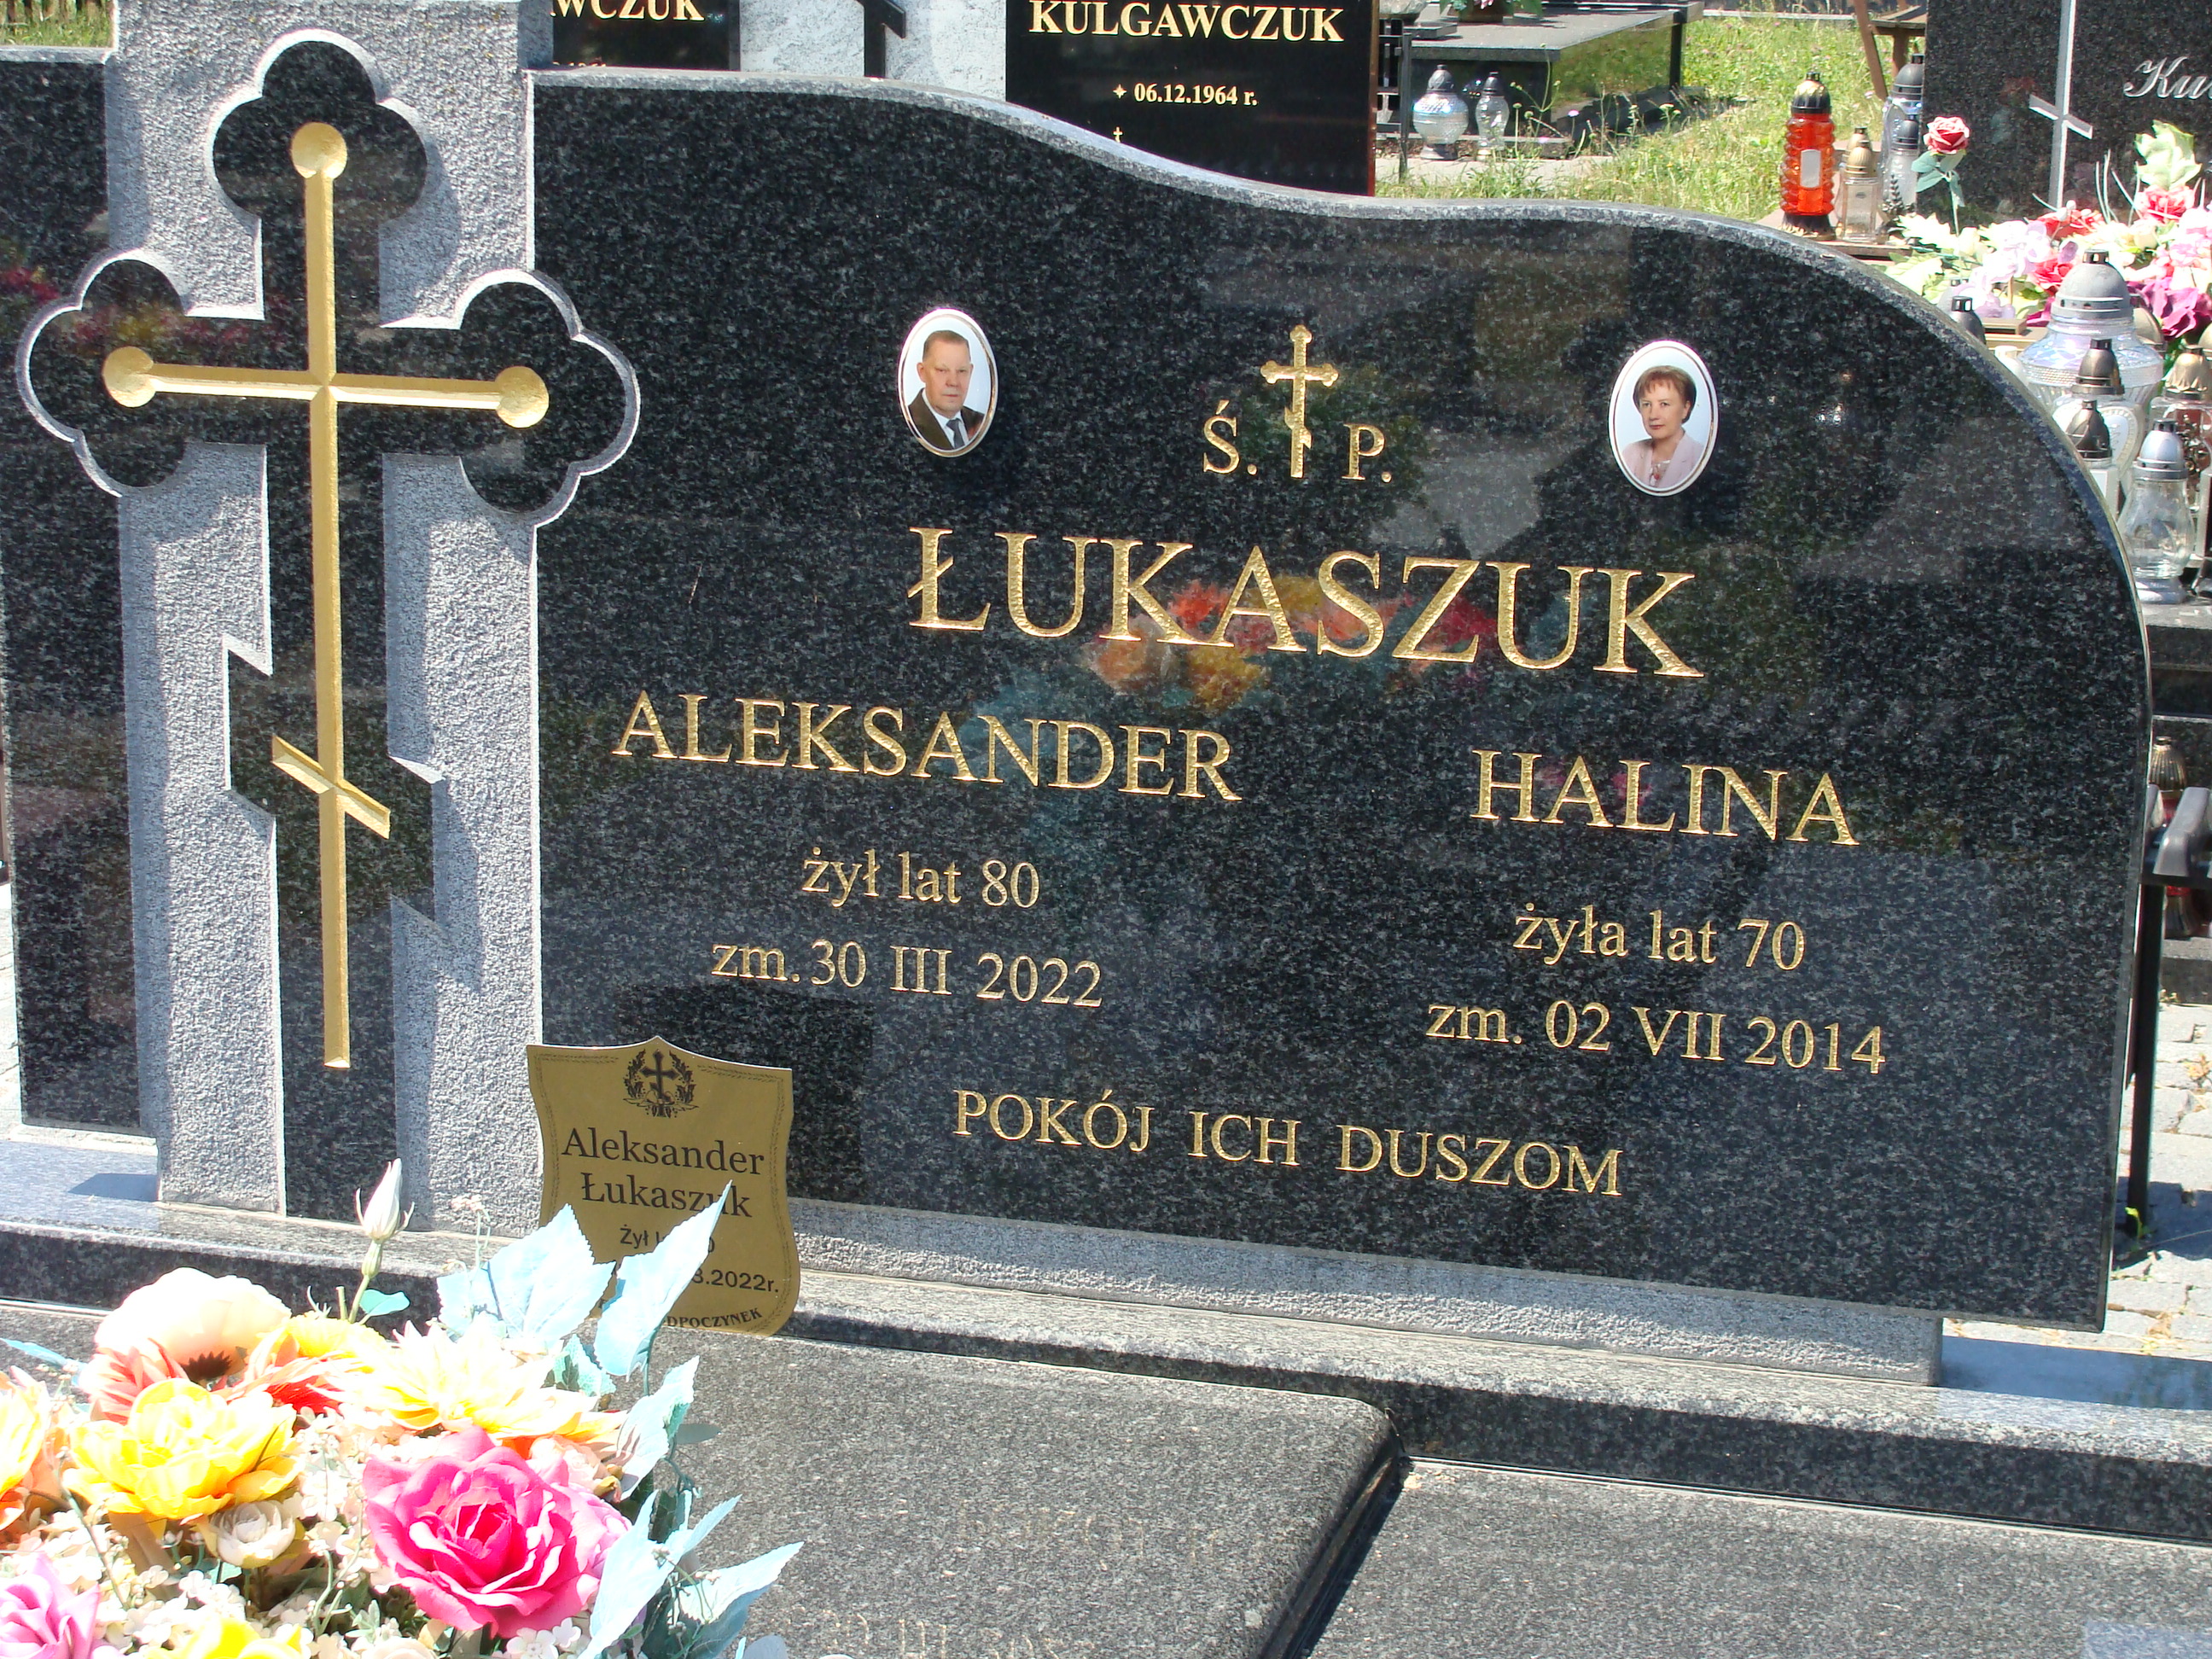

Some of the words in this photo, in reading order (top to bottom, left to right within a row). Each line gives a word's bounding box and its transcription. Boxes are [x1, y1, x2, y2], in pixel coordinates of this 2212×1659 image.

[550, 0, 706, 21] WCZUK
[1029, 0, 1344, 42] KULGAWCZUK
[1133, 83, 1237, 106] 06.12.1964
[1243, 90, 1259, 106] r.
[2123, 56, 2212, 99] Ku
[1203, 399, 1258, 474] Ś.
[1341, 423, 1393, 483] P.
[907, 527, 1704, 678] ŁUKASZUK
[611, 690, 1243, 800] ALEKSANDER
[1470, 749, 1860, 846] HALINA
[802, 847, 879, 908] żył
[898, 851, 962, 905] lat
[981, 859, 1041, 909] 80
[1512, 902, 1628, 965] żyła
[1648, 910, 1717, 963] lat
[1737, 918, 1806, 971] 70
[890, 946, 952, 996] III
[975, 952, 1103, 1008] 2022
[1426, 1003, 1522, 1045] zm.
[1545, 1000, 1611, 1051] 02
[1632, 1006, 1726, 1061] VII
[1744, 1016, 1886, 1074] 2014
[561, 1127, 765, 1175] Aleksander
[952, 1089, 1155, 1152] POKÓJ
[1187, 1110, 1301, 1167] ICH
[1336, 1124, 1624, 1196] DUSZOM
[620, 1224, 649, 1249] Żył
[663, 1307, 762, 1328] DPOCZYNEK
